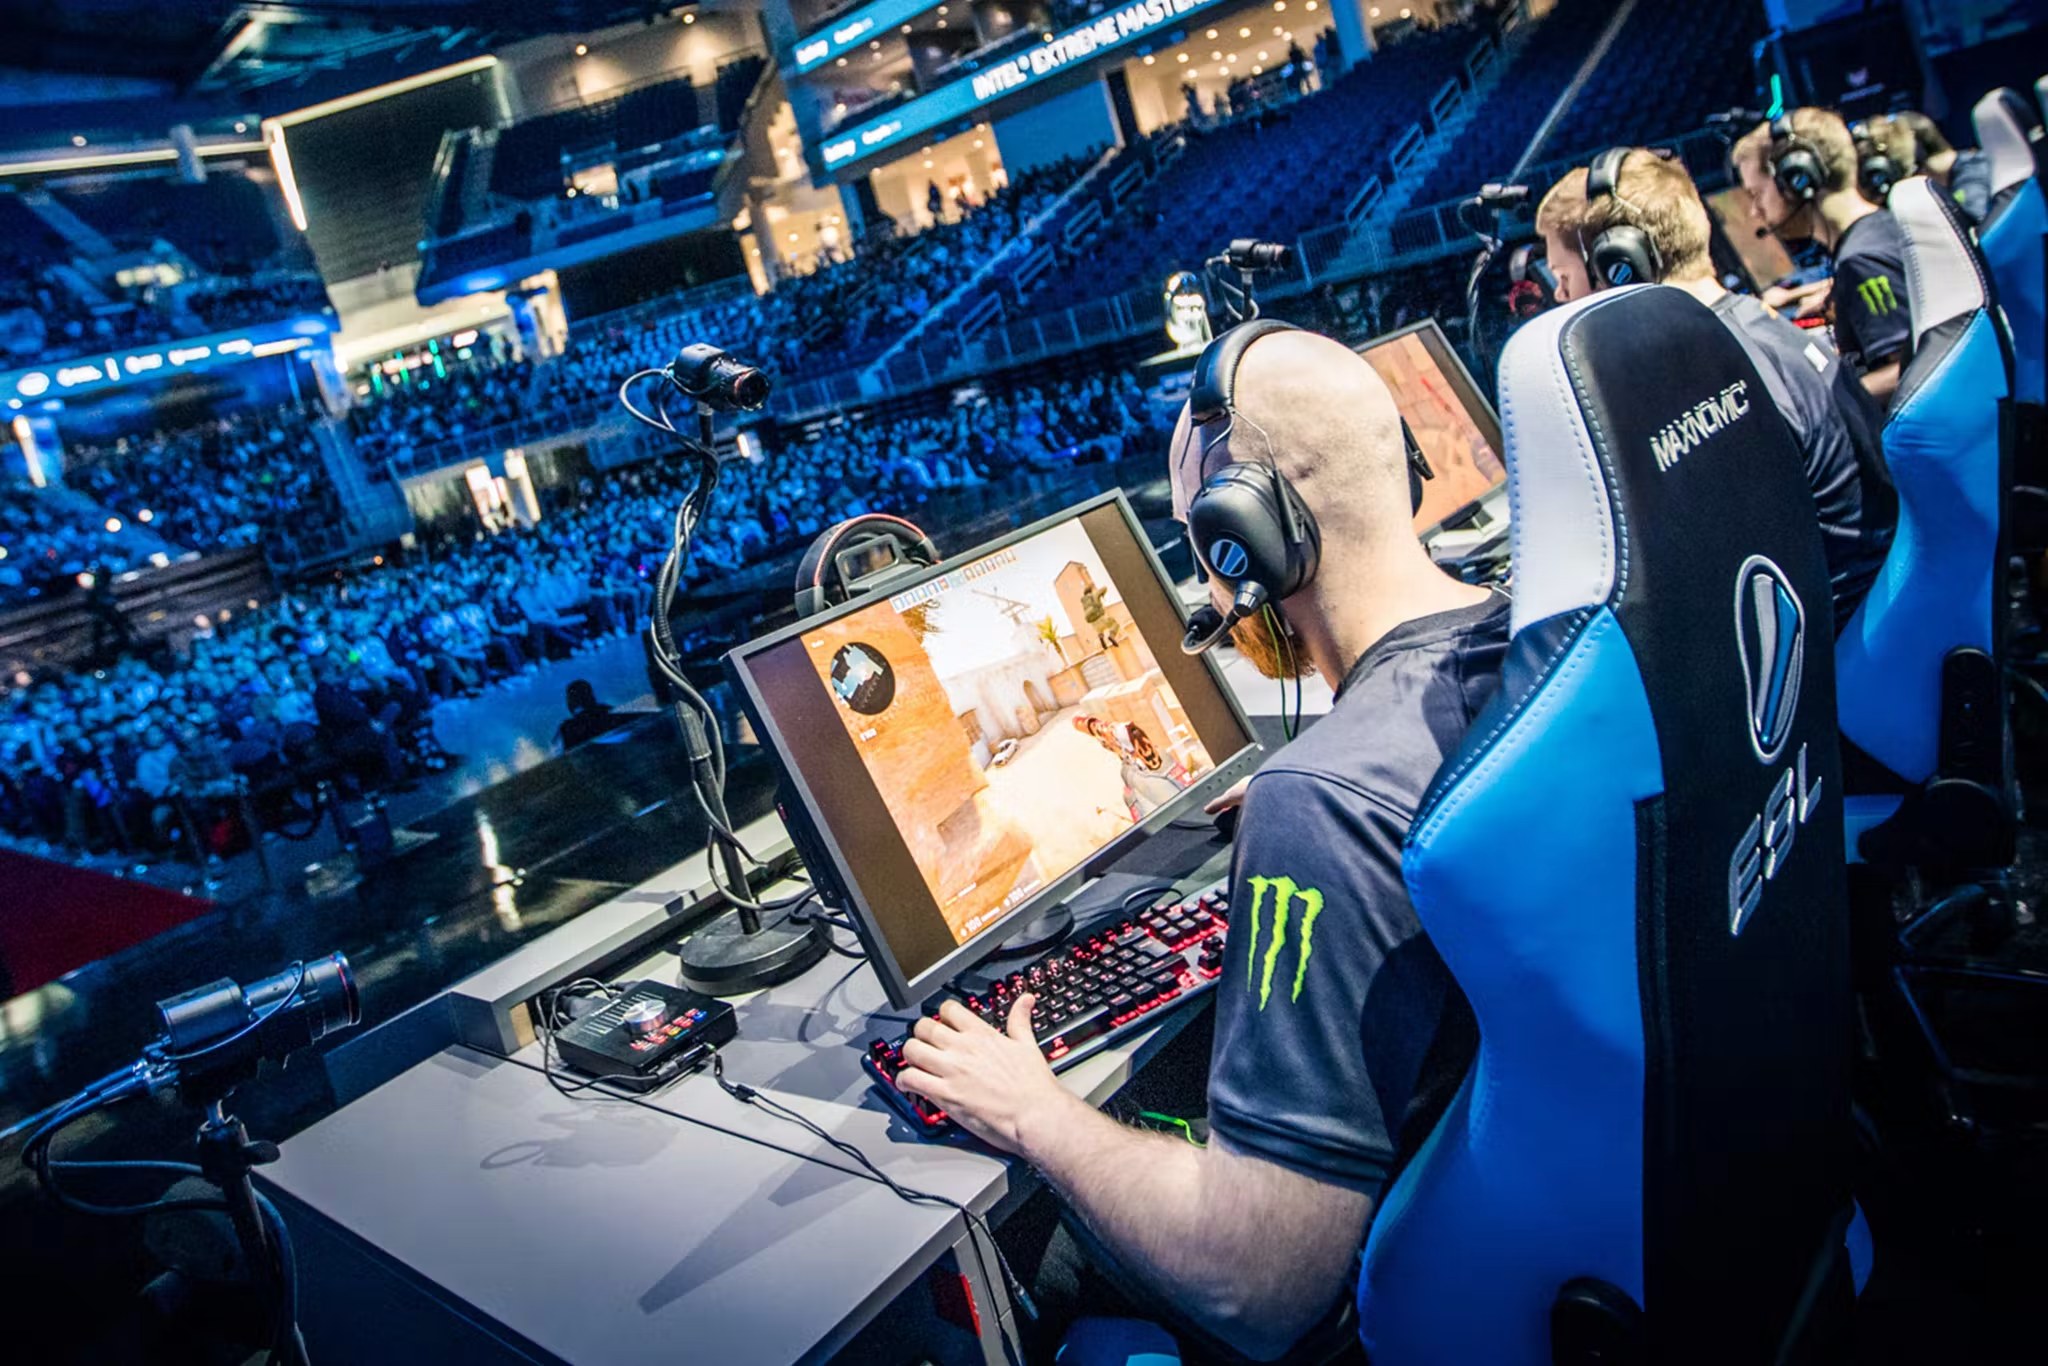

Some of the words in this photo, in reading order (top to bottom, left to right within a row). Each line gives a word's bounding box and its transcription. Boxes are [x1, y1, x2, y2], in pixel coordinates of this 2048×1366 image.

[1029, 16, 1120, 75] EXTREME
[1116, 0, 1211, 37] MAST
[1649, 379, 1750, 472] MAXNOMIC
[1728, 741, 1822, 936] ESL
